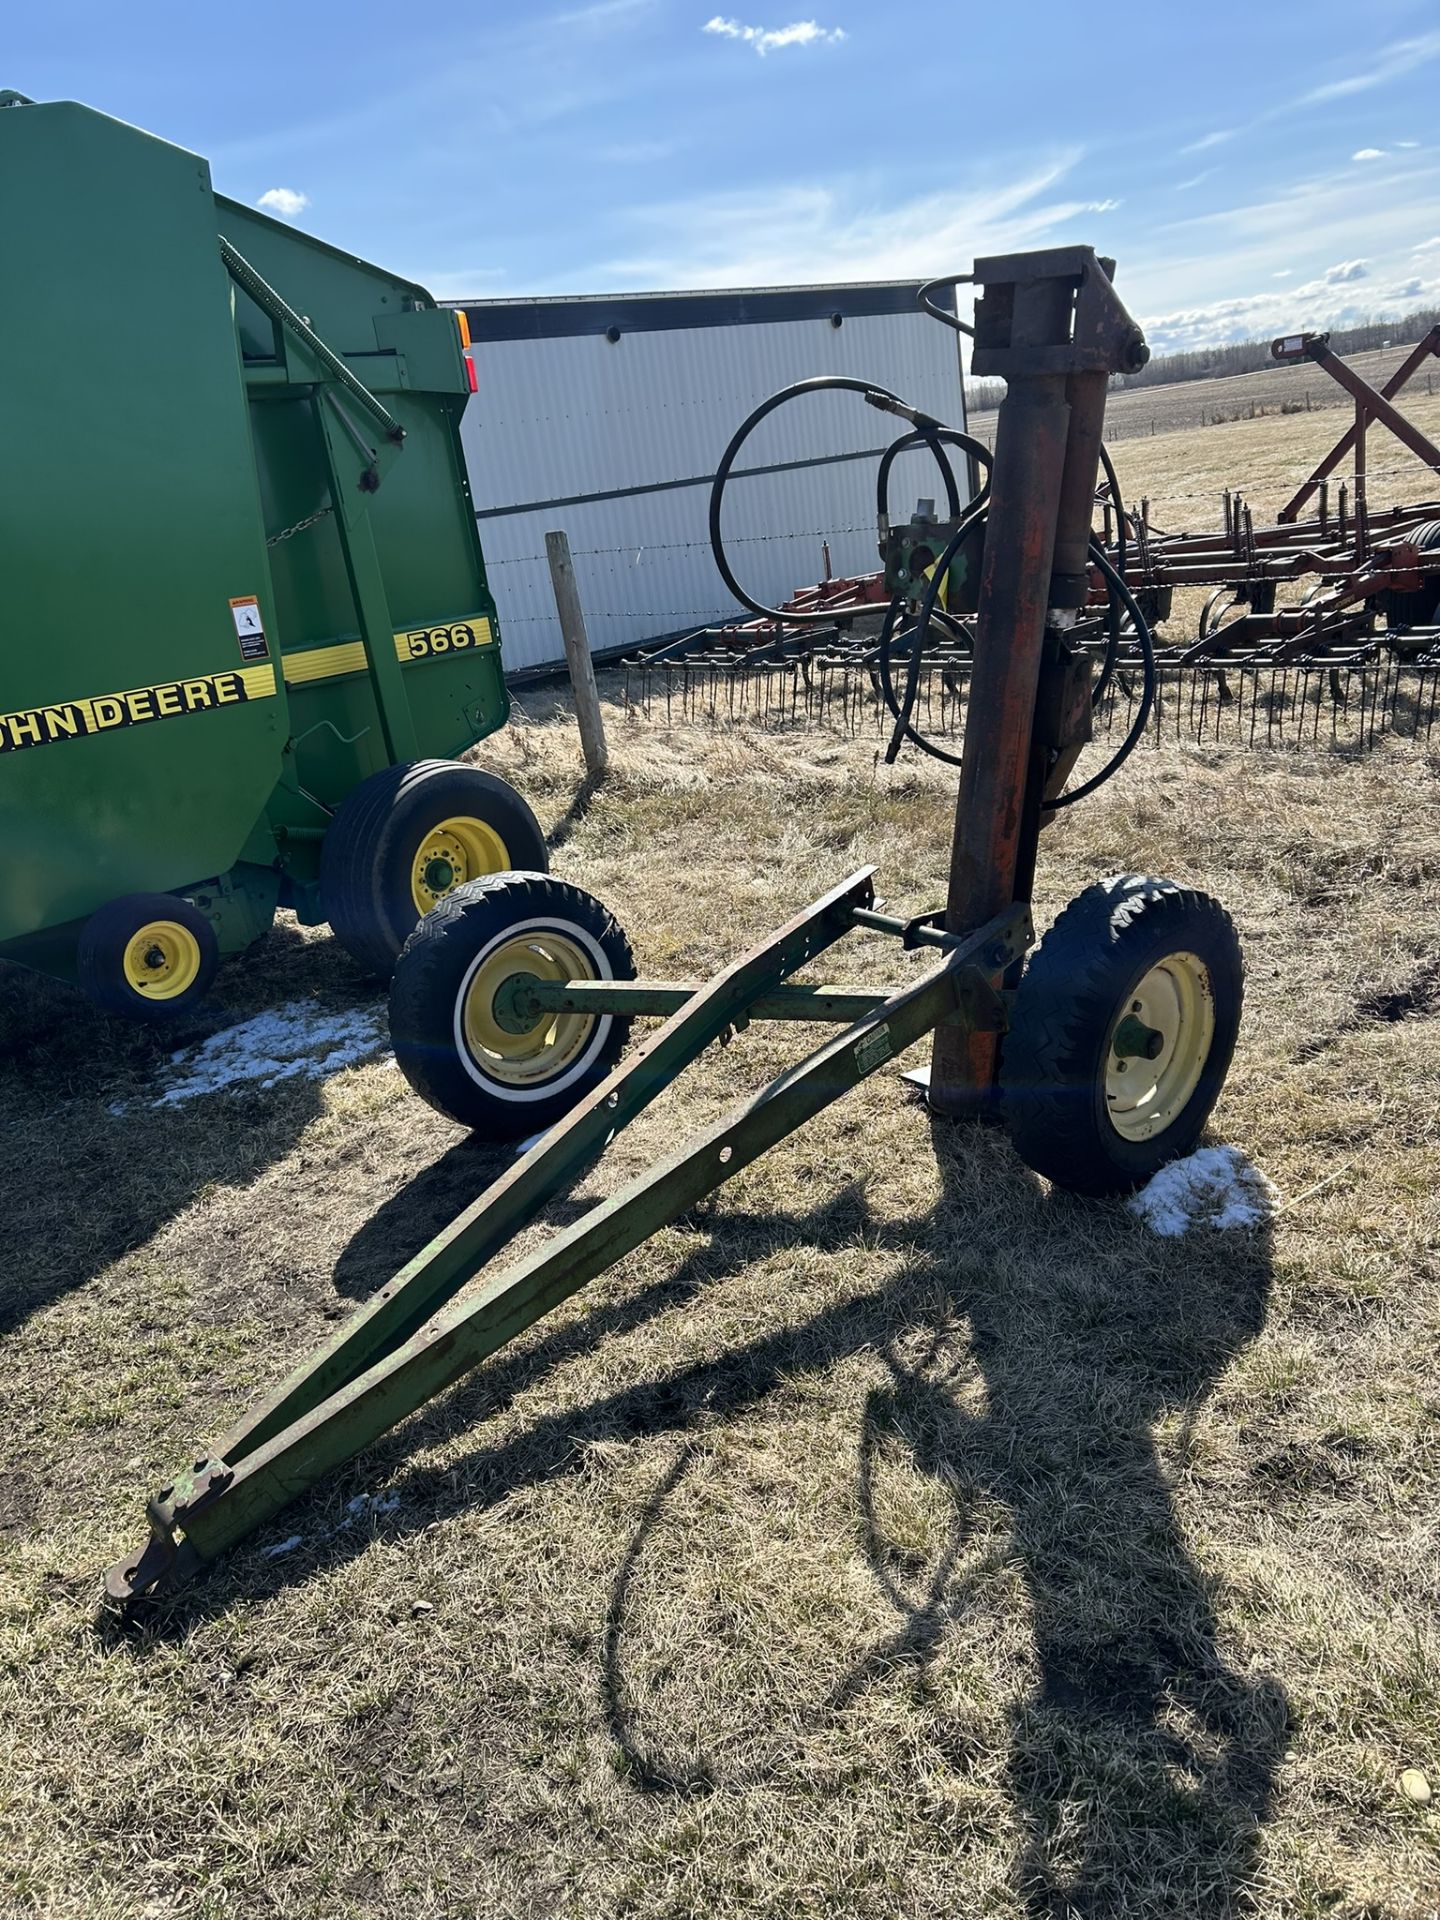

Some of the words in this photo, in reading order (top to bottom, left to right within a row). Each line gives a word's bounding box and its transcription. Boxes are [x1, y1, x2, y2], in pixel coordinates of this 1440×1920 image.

[408, 624, 471, 657] 566
[0, 707, 78, 748] HN
[92, 674, 241, 730] DEERE
